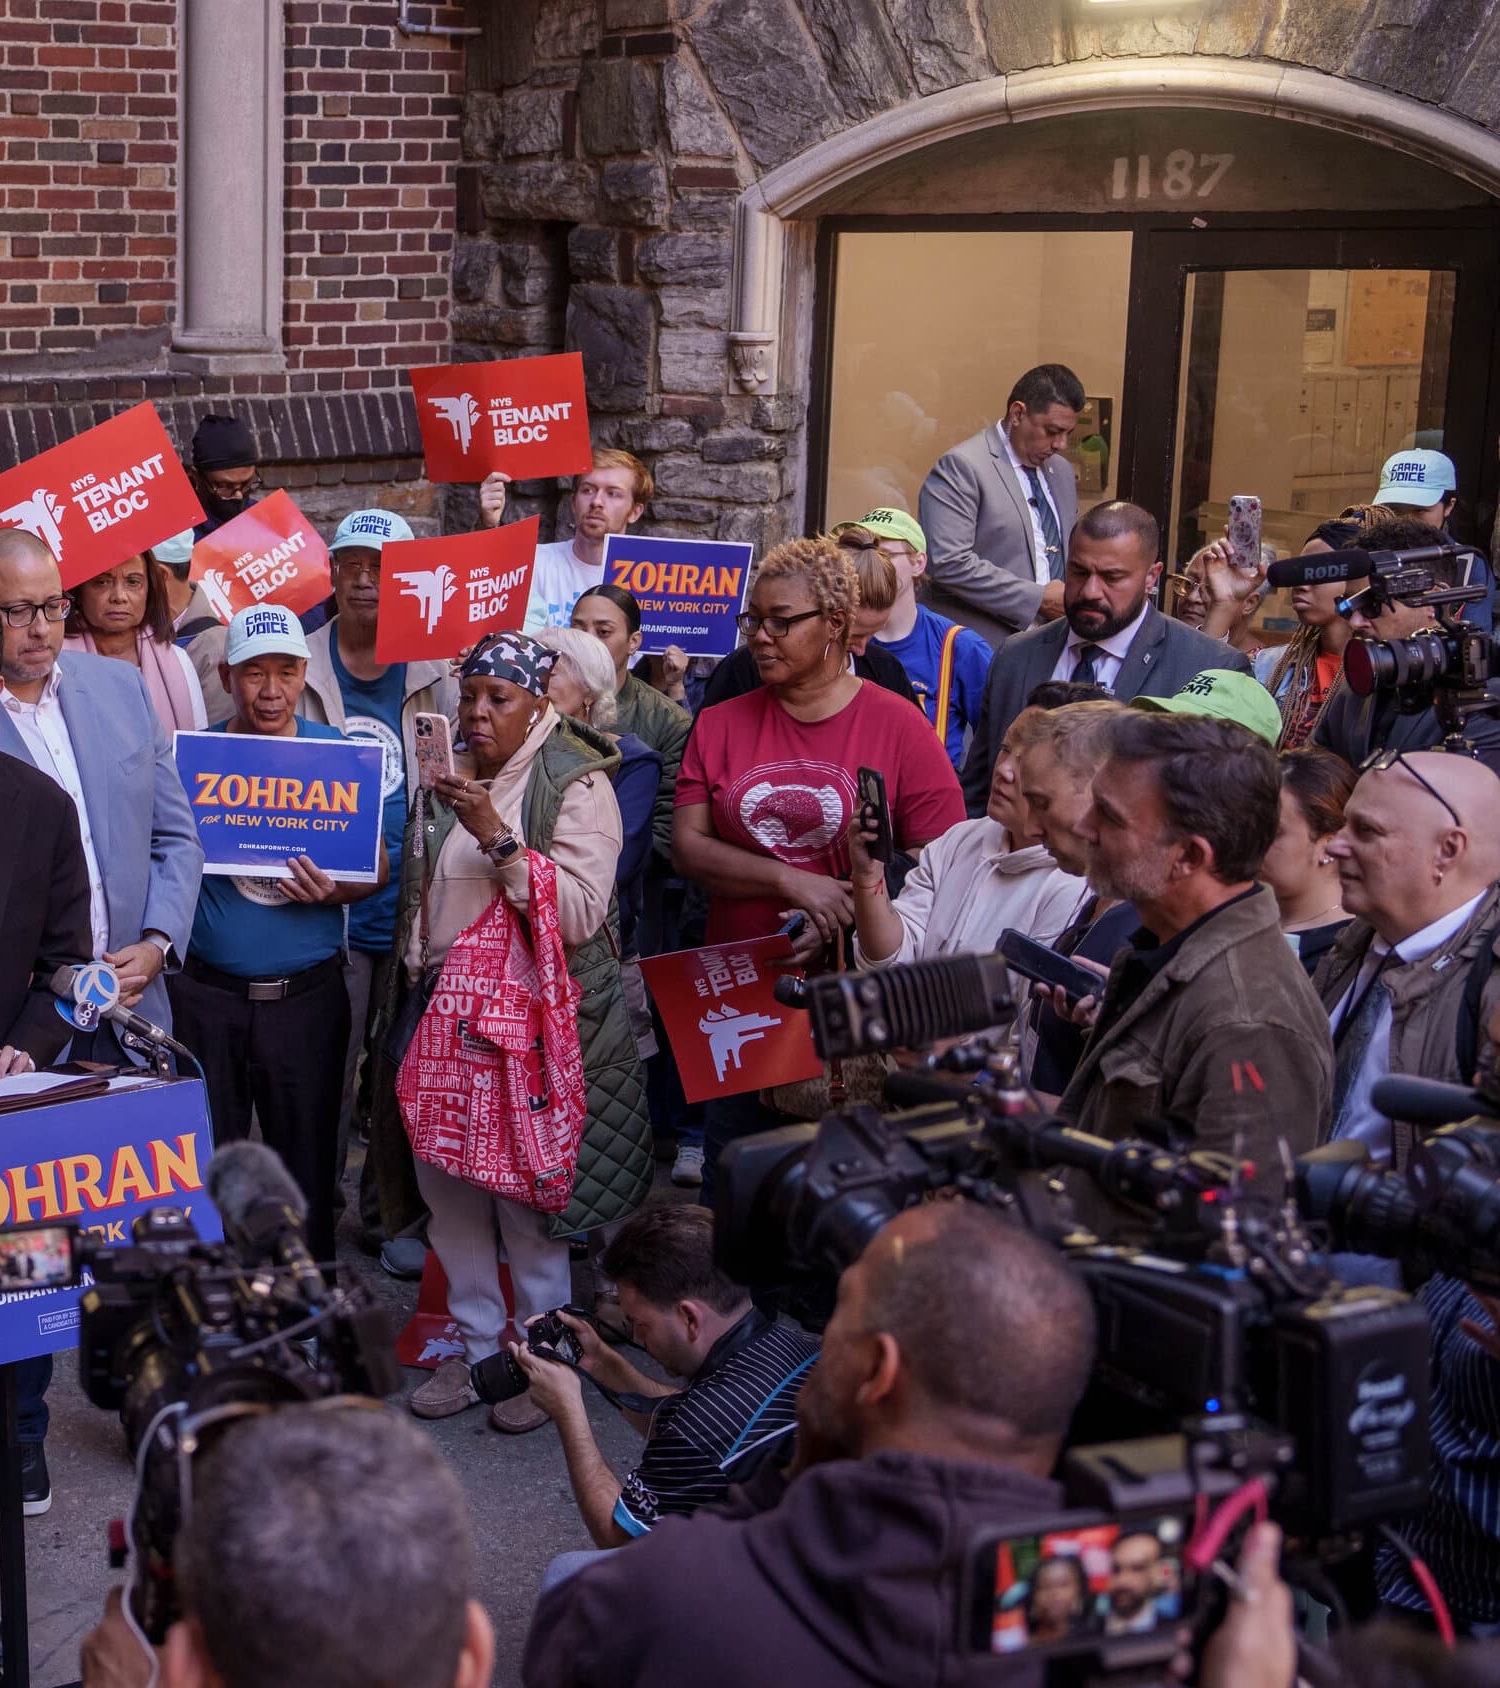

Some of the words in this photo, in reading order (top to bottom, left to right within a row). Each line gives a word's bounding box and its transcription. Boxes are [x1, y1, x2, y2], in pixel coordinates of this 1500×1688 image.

[1111, 149, 1235, 199] 1187
[490, 397, 513, 407] NYS
[487, 402, 572, 427] TENANT
[494, 424, 549, 446] BLOC
[70, 473, 96, 492] NYS
[71, 453, 165, 513] TENANT
[1390, 472, 1425, 482] VOICE
[86, 489, 149, 533] BLOC
[351, 524, 392, 538] VOICE
[233, 552, 256, 569] NYS
[236, 531, 307, 586] TENANT
[250, 561, 299, 601] BLOC
[465, 564, 528, 601] TENANT
[470, 567, 490, 579] NYS
[611, 560, 743, 597] ZOHRAN
[468, 593, 509, 622] BLOC
[668, 601, 700, 614] YORK
[702, 603, 730, 615] CITY
[246, 621, 290, 638] VOICE
[639, 623, 709, 635] HRANFORNYC.COM
[193, 773, 361, 814] ZOHRAN
[200, 815, 221, 825] FOR
[224, 814, 262, 827] NEW
[266, 816, 309, 830] YORK
[312, 818, 349, 832] CITY
[238, 843, 307, 853] ZOHRANFORNYC.COM
[697, 950, 735, 998] TENANT
[728, 953, 759, 986] BLOC
[434, 974, 501, 995] RINGI
[694, 978, 710, 997] NYS
[80, 1002, 95, 1026] abc
[424, 992, 474, 1016] YOU
[418, 1073, 462, 1090] ADVENTURE
[480, 1093, 491, 1132] LOVE
[437, 1094, 469, 1161] LIFE
[467, 1090, 480, 1165] EVERYTHING
[489, 1114, 500, 1150] MUCH
[475, 1132, 488, 1168] YOU
[532, 1117, 557, 1167] FEEDING
[488, 1153, 498, 1170] SO
